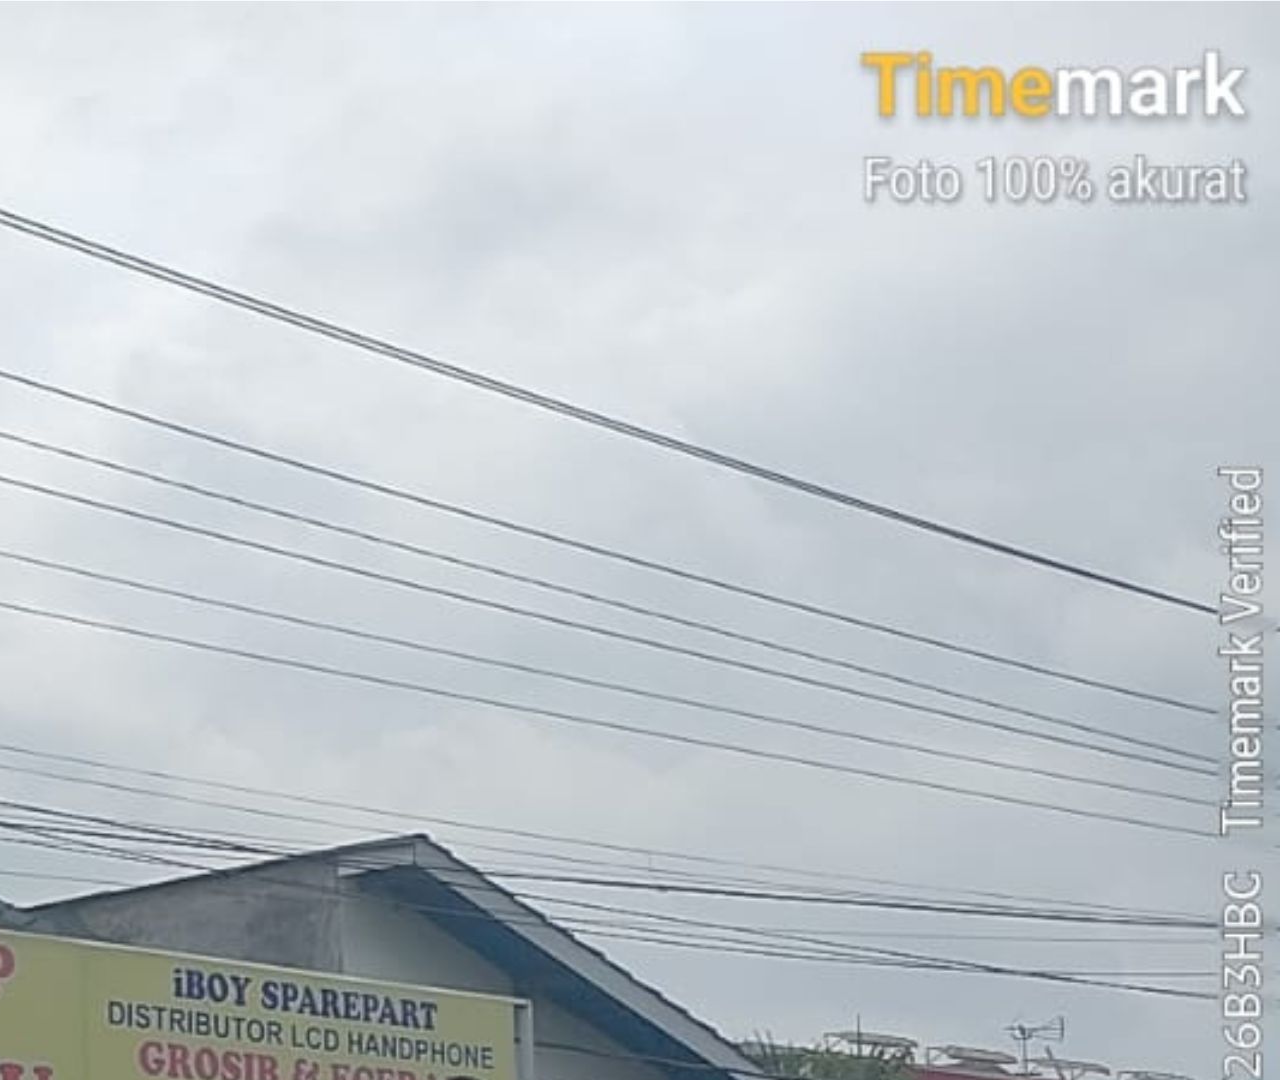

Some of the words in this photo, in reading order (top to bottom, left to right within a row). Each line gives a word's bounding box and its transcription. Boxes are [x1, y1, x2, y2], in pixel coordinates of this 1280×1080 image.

[173, 967, 251, 1002] iBOY
[261, 978, 438, 1031] SPAREPART
[108, 1000, 284, 1046] DISTRIBUTOR
[292, 1024, 341, 1053] LCD
[347, 1033, 495, 1071] HANDPHONE
